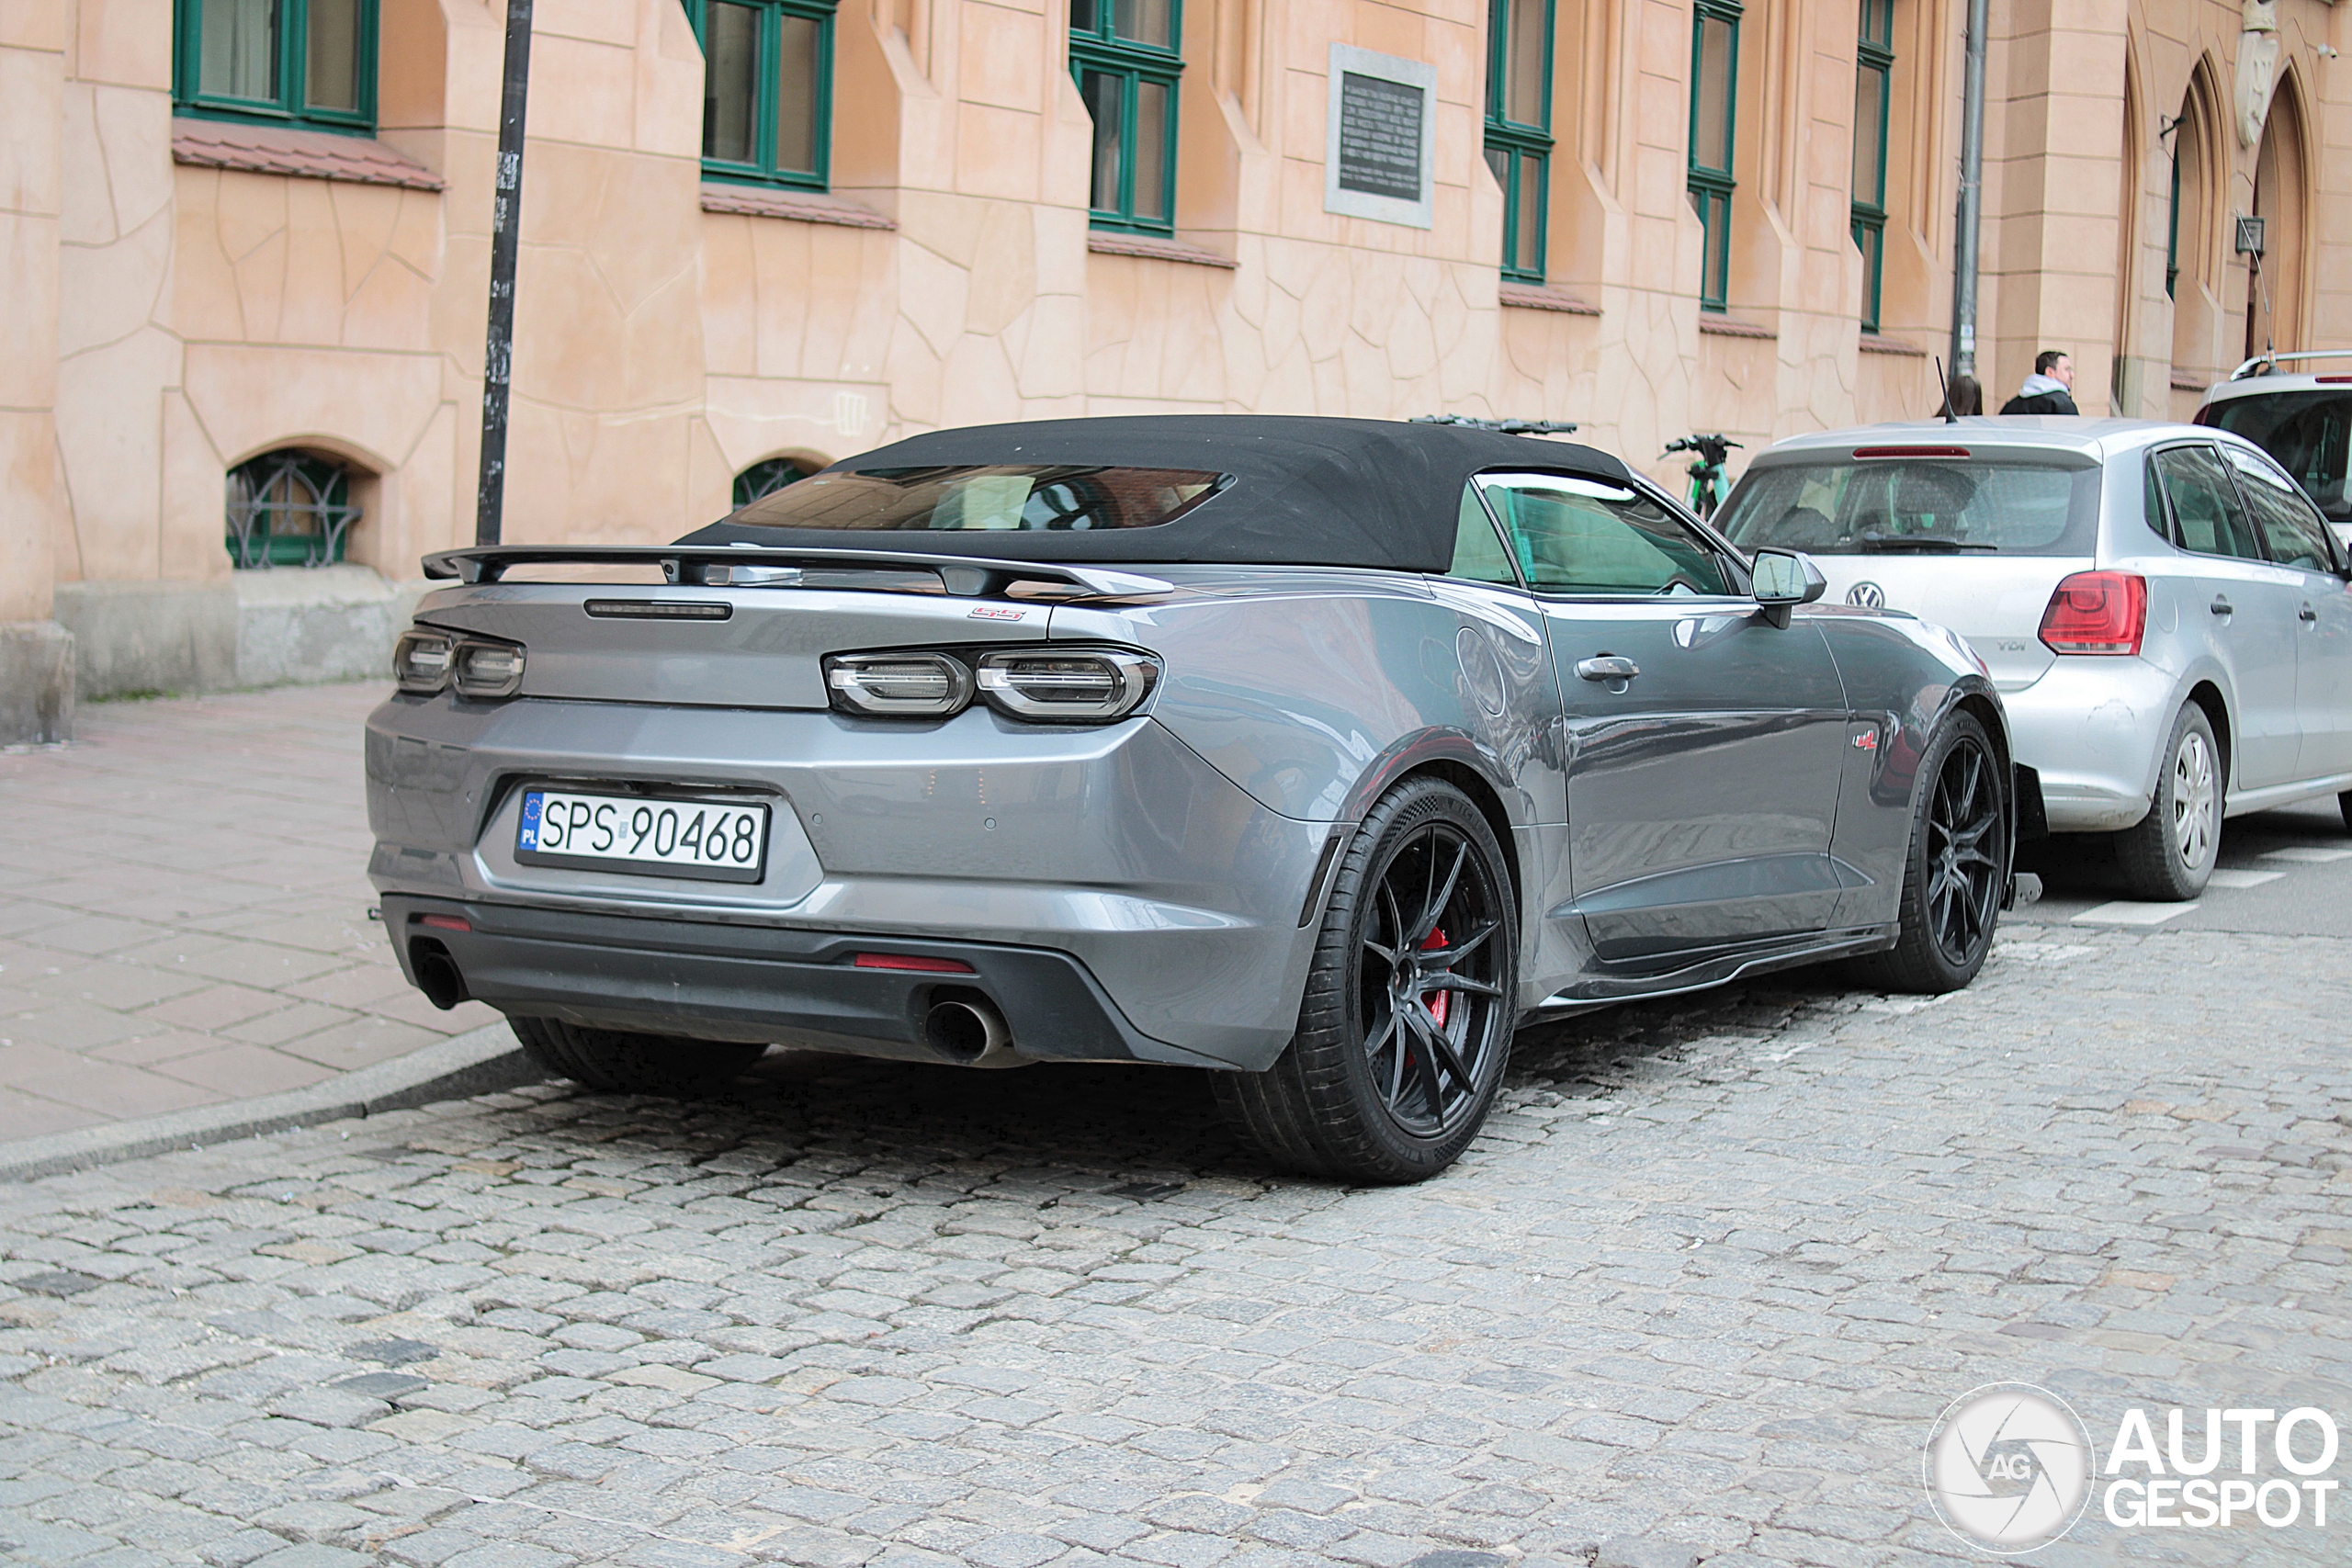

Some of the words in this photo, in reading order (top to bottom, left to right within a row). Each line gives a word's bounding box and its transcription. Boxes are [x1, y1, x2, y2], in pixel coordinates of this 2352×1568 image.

[967, 607, 1026, 621] SS
[522, 829, 537, 844] PL
[542, 800, 617, 852] SPS
[628, 807, 756, 863] 90468
